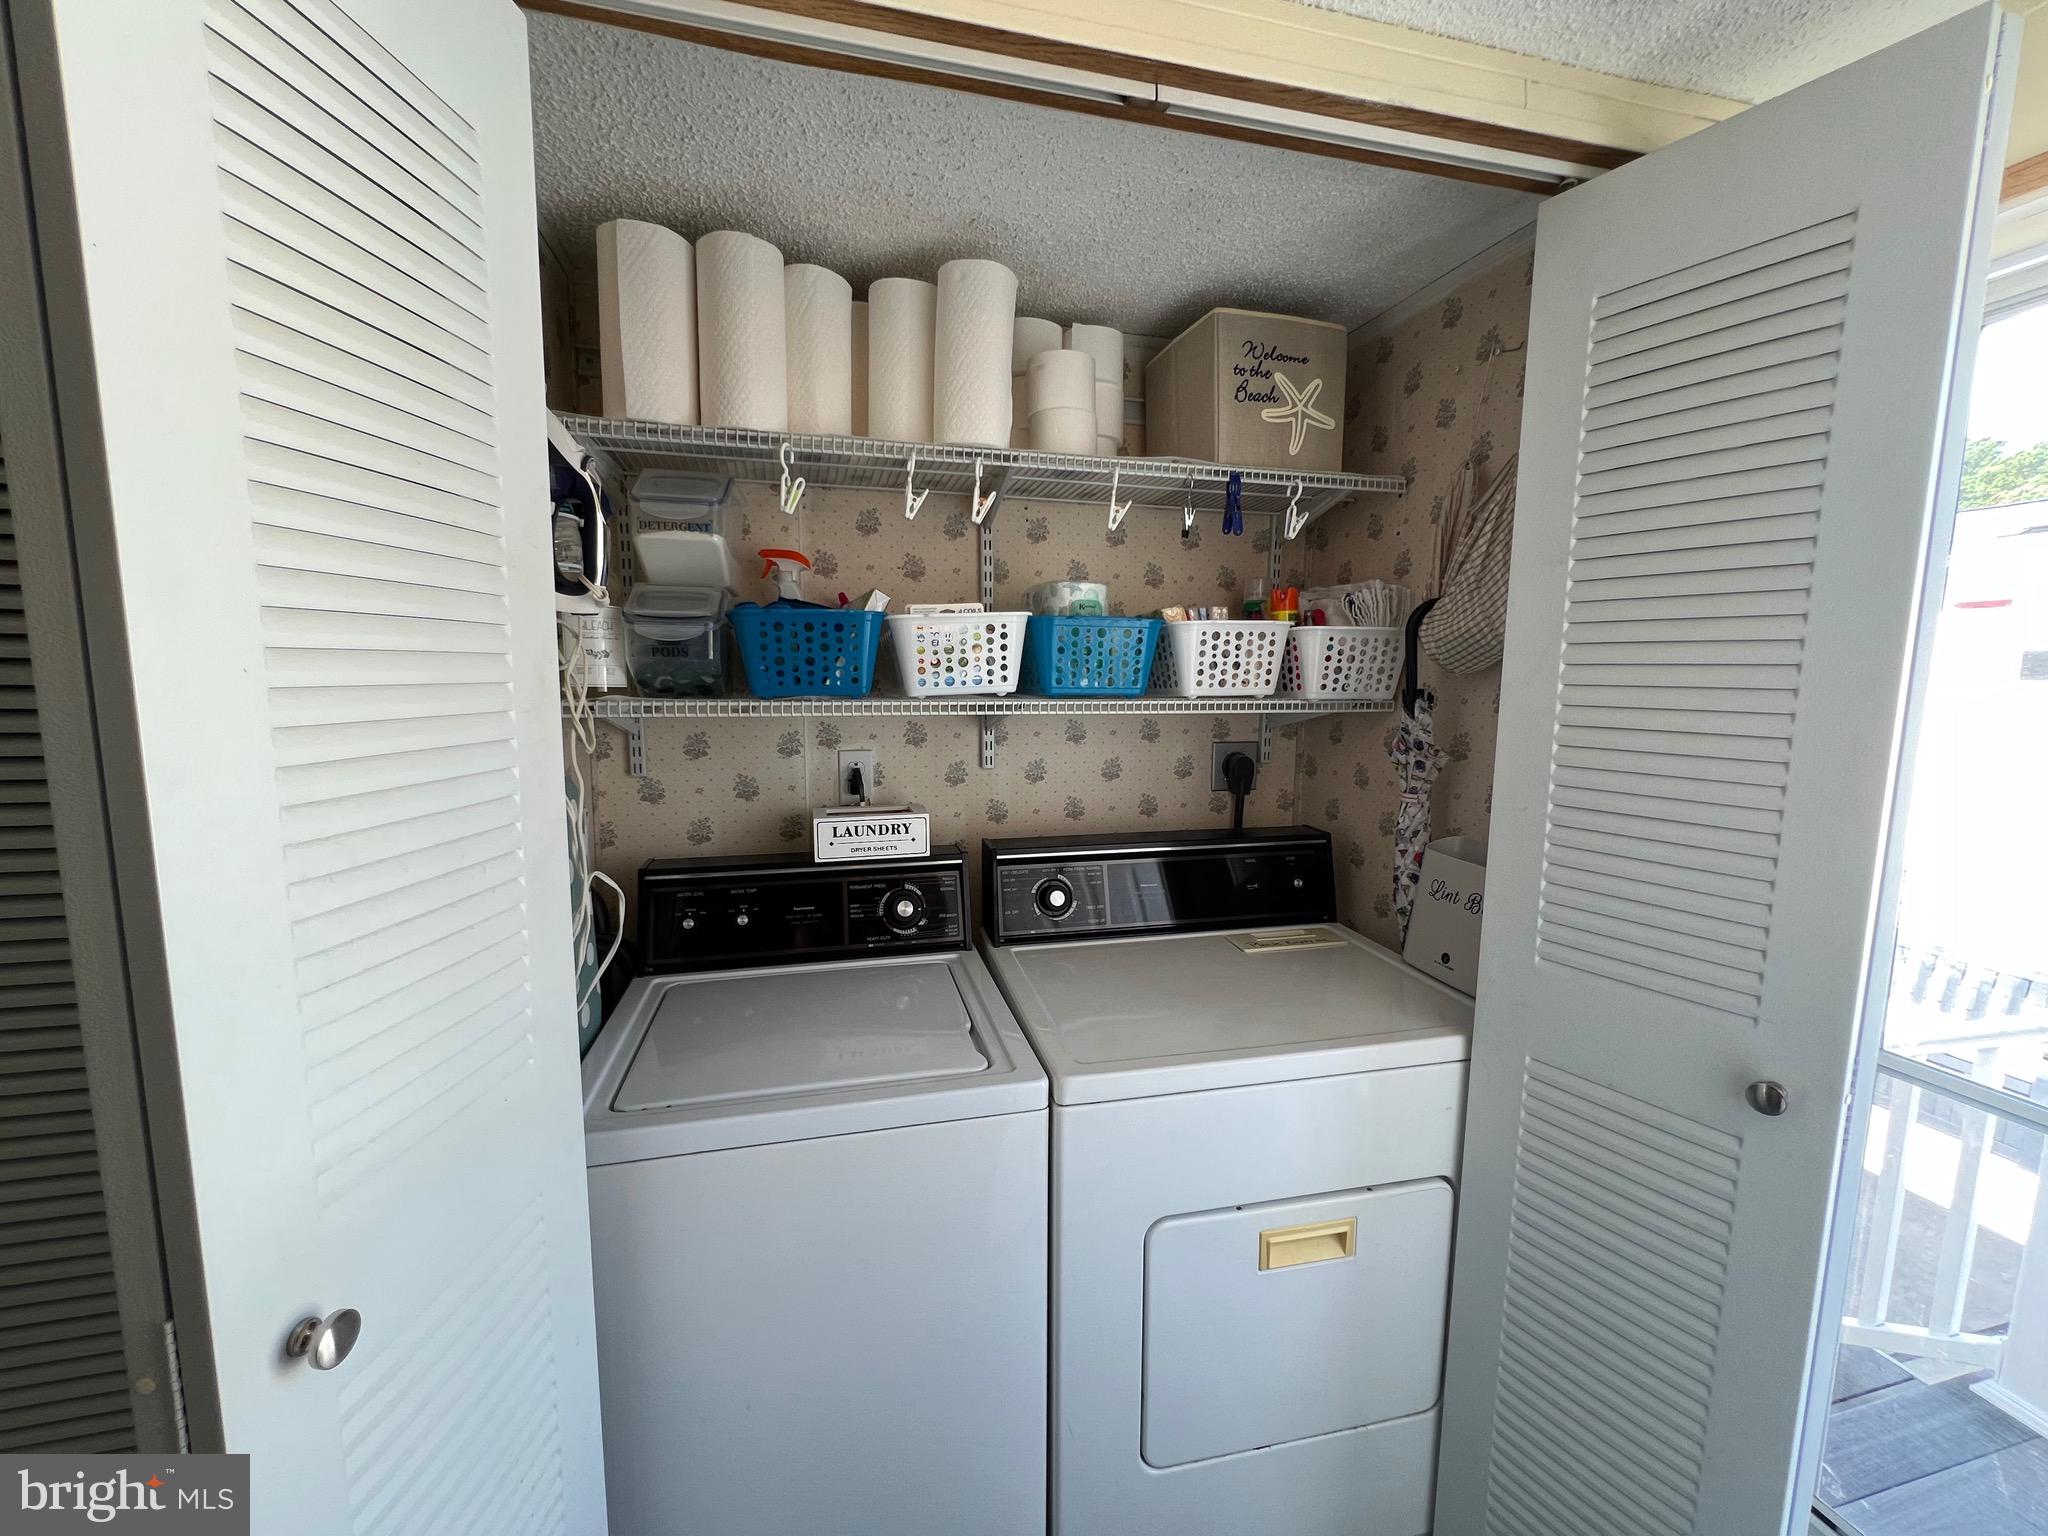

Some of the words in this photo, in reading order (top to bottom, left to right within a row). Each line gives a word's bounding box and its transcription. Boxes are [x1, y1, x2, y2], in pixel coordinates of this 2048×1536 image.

[1242, 340, 1310, 365] Welcome
[1233, 364, 1248, 377] to
[1249, 360, 1272, 379] the
[1234, 379, 1280, 403] Beach
[638, 520, 712, 532] DETERGENT
[651, 646, 689, 657] PODS
[832, 823, 912, 838] LAUNDRY
[1428, 878, 1460, 904] Lint
[1464, 892, 1484, 915] B
